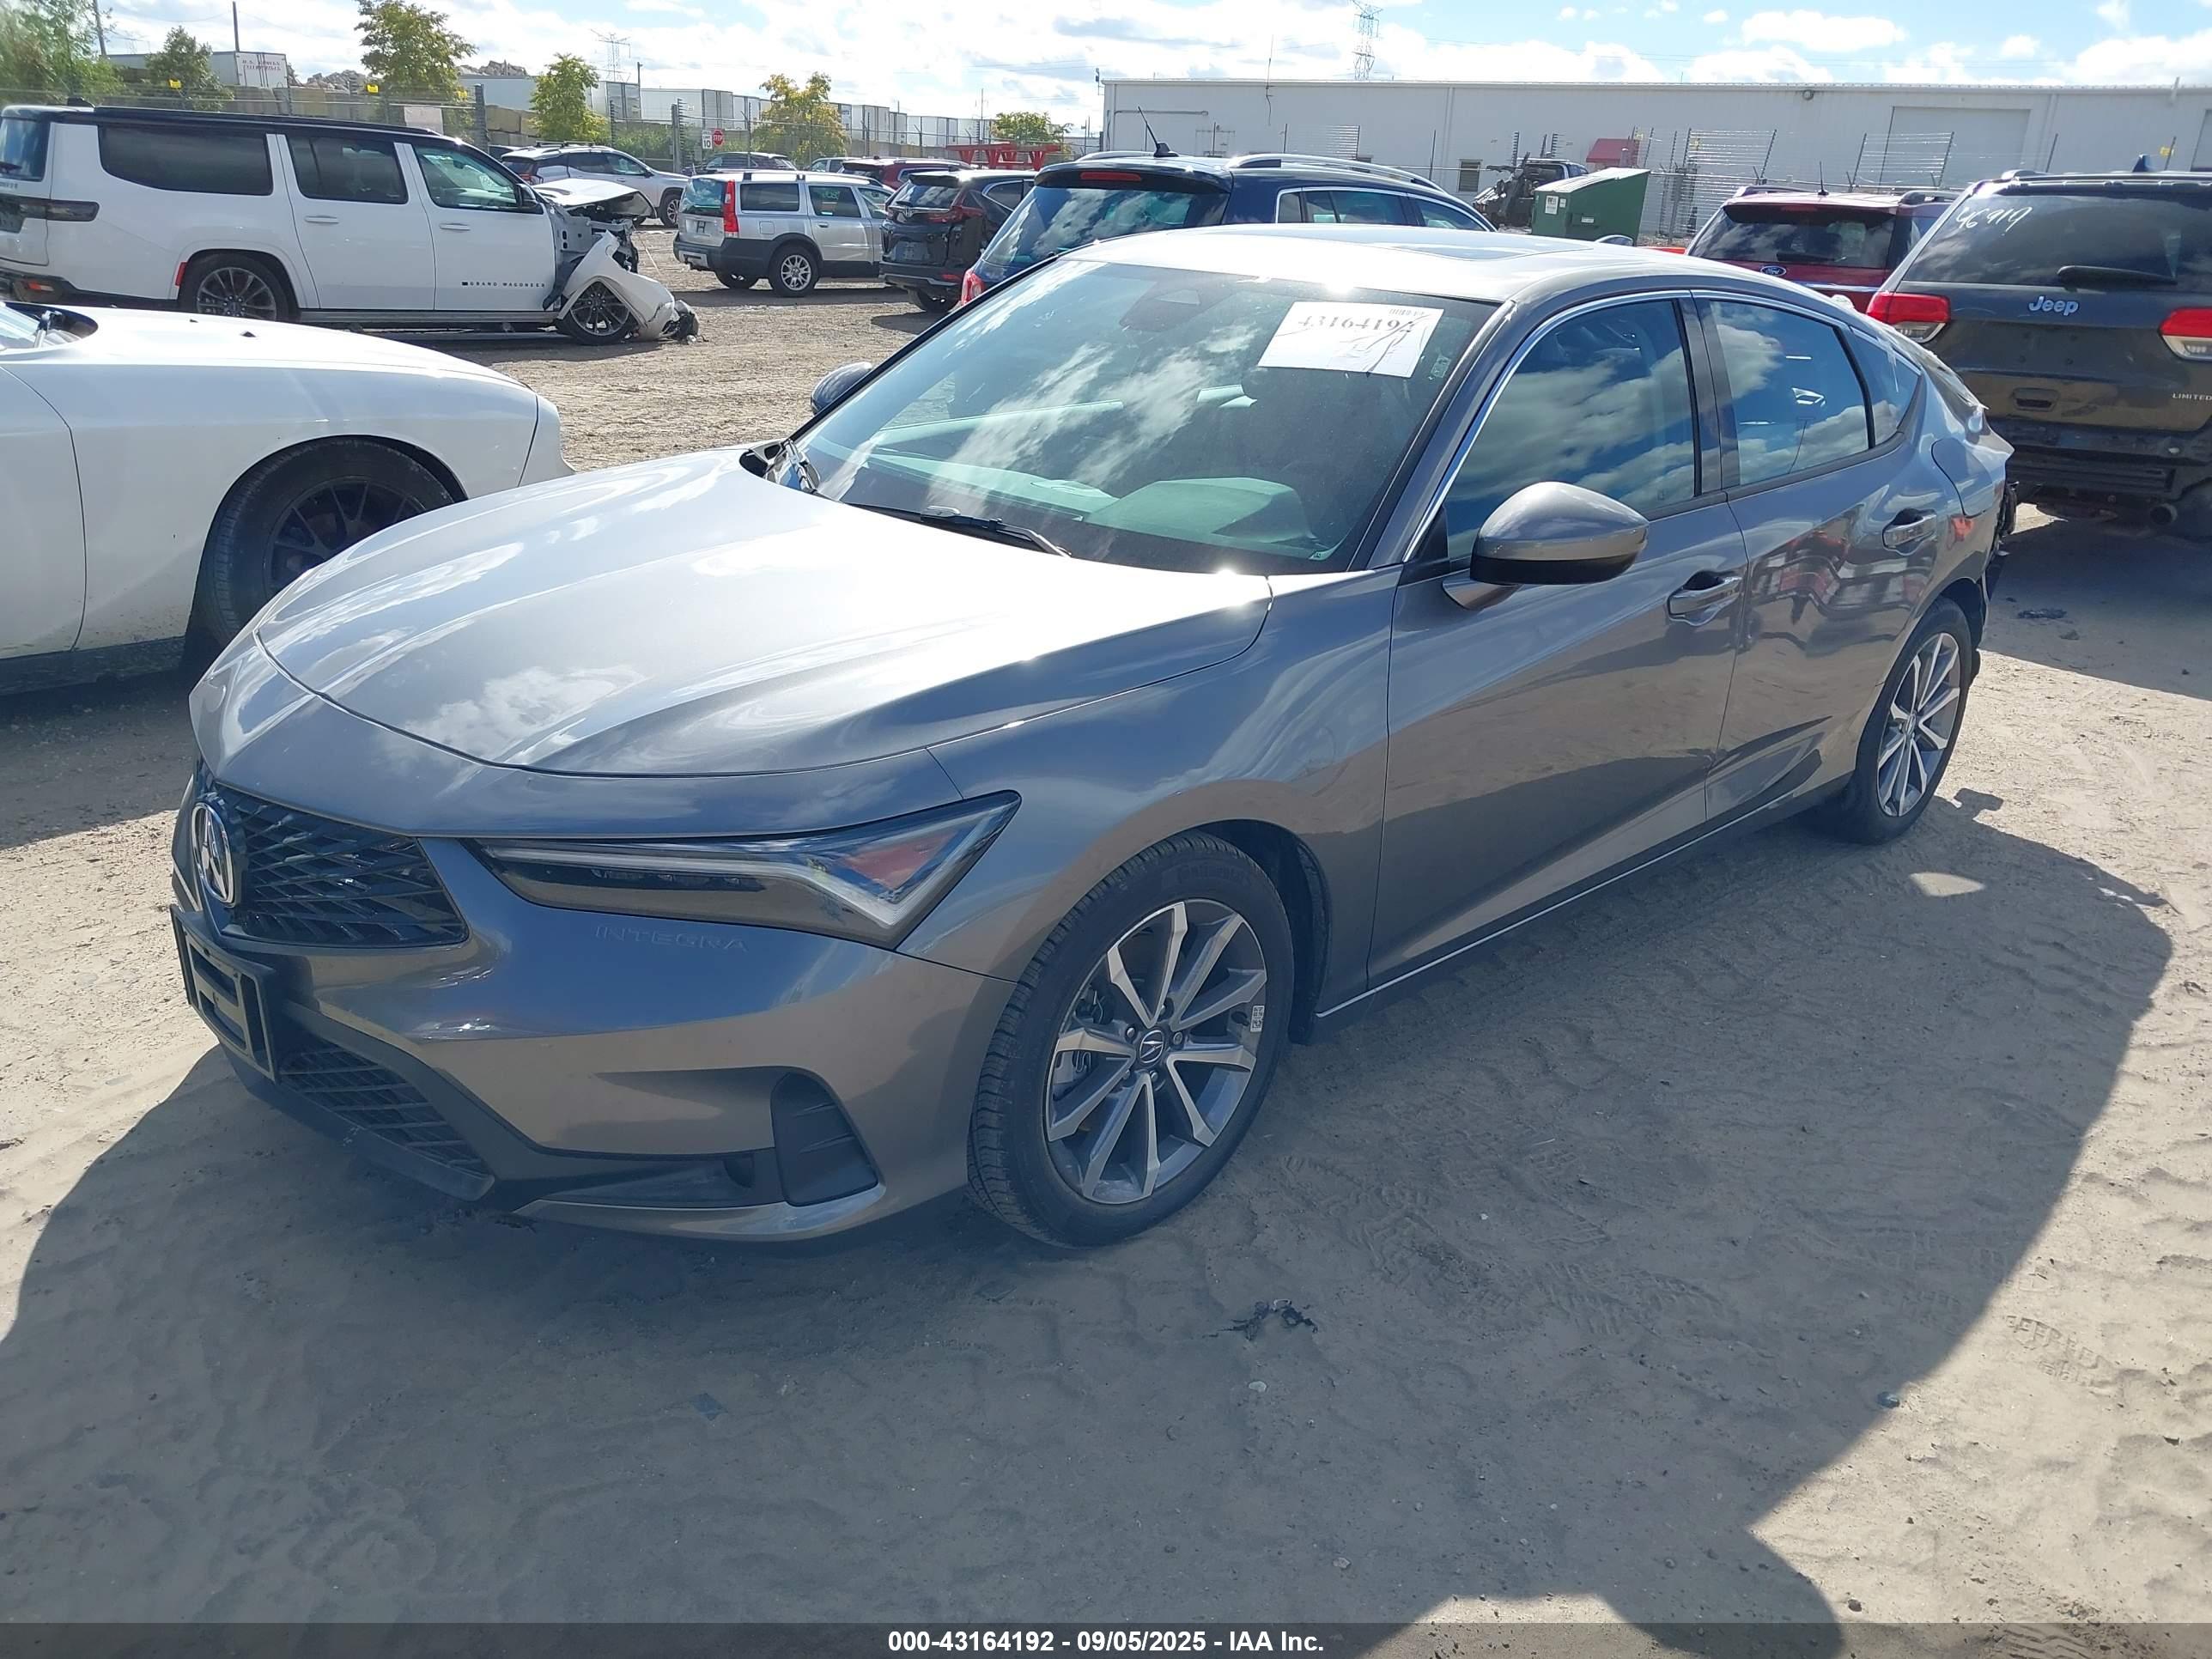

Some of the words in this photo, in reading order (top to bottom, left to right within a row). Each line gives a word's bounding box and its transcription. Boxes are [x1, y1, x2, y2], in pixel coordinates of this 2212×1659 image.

[703, 139, 711, 148] 10
[2029, 295, 2079, 316] Jeep
[595, 926, 749, 953] INTEGRA
